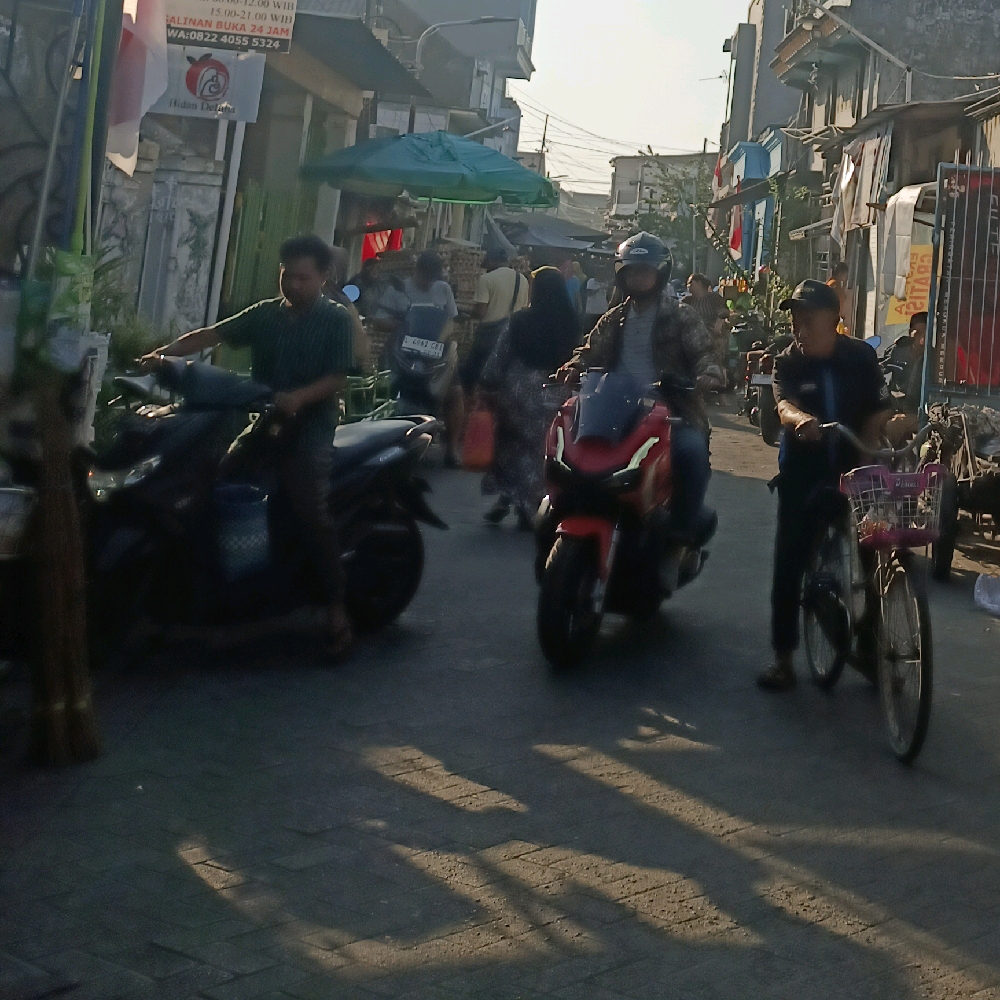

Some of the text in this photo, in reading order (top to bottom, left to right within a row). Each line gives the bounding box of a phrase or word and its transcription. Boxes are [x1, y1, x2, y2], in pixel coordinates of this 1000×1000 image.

[272, 0, 295, 10] WIB
[210, 7, 293, 24] 15.00-21.00 WIB
[215, 20, 246, 32] BUKA
[250, 23, 263, 34] 24
[266, 26, 290, 37] JAM
[220, 34, 250, 46] 4055
[251, 37, 281, 49] 5324
